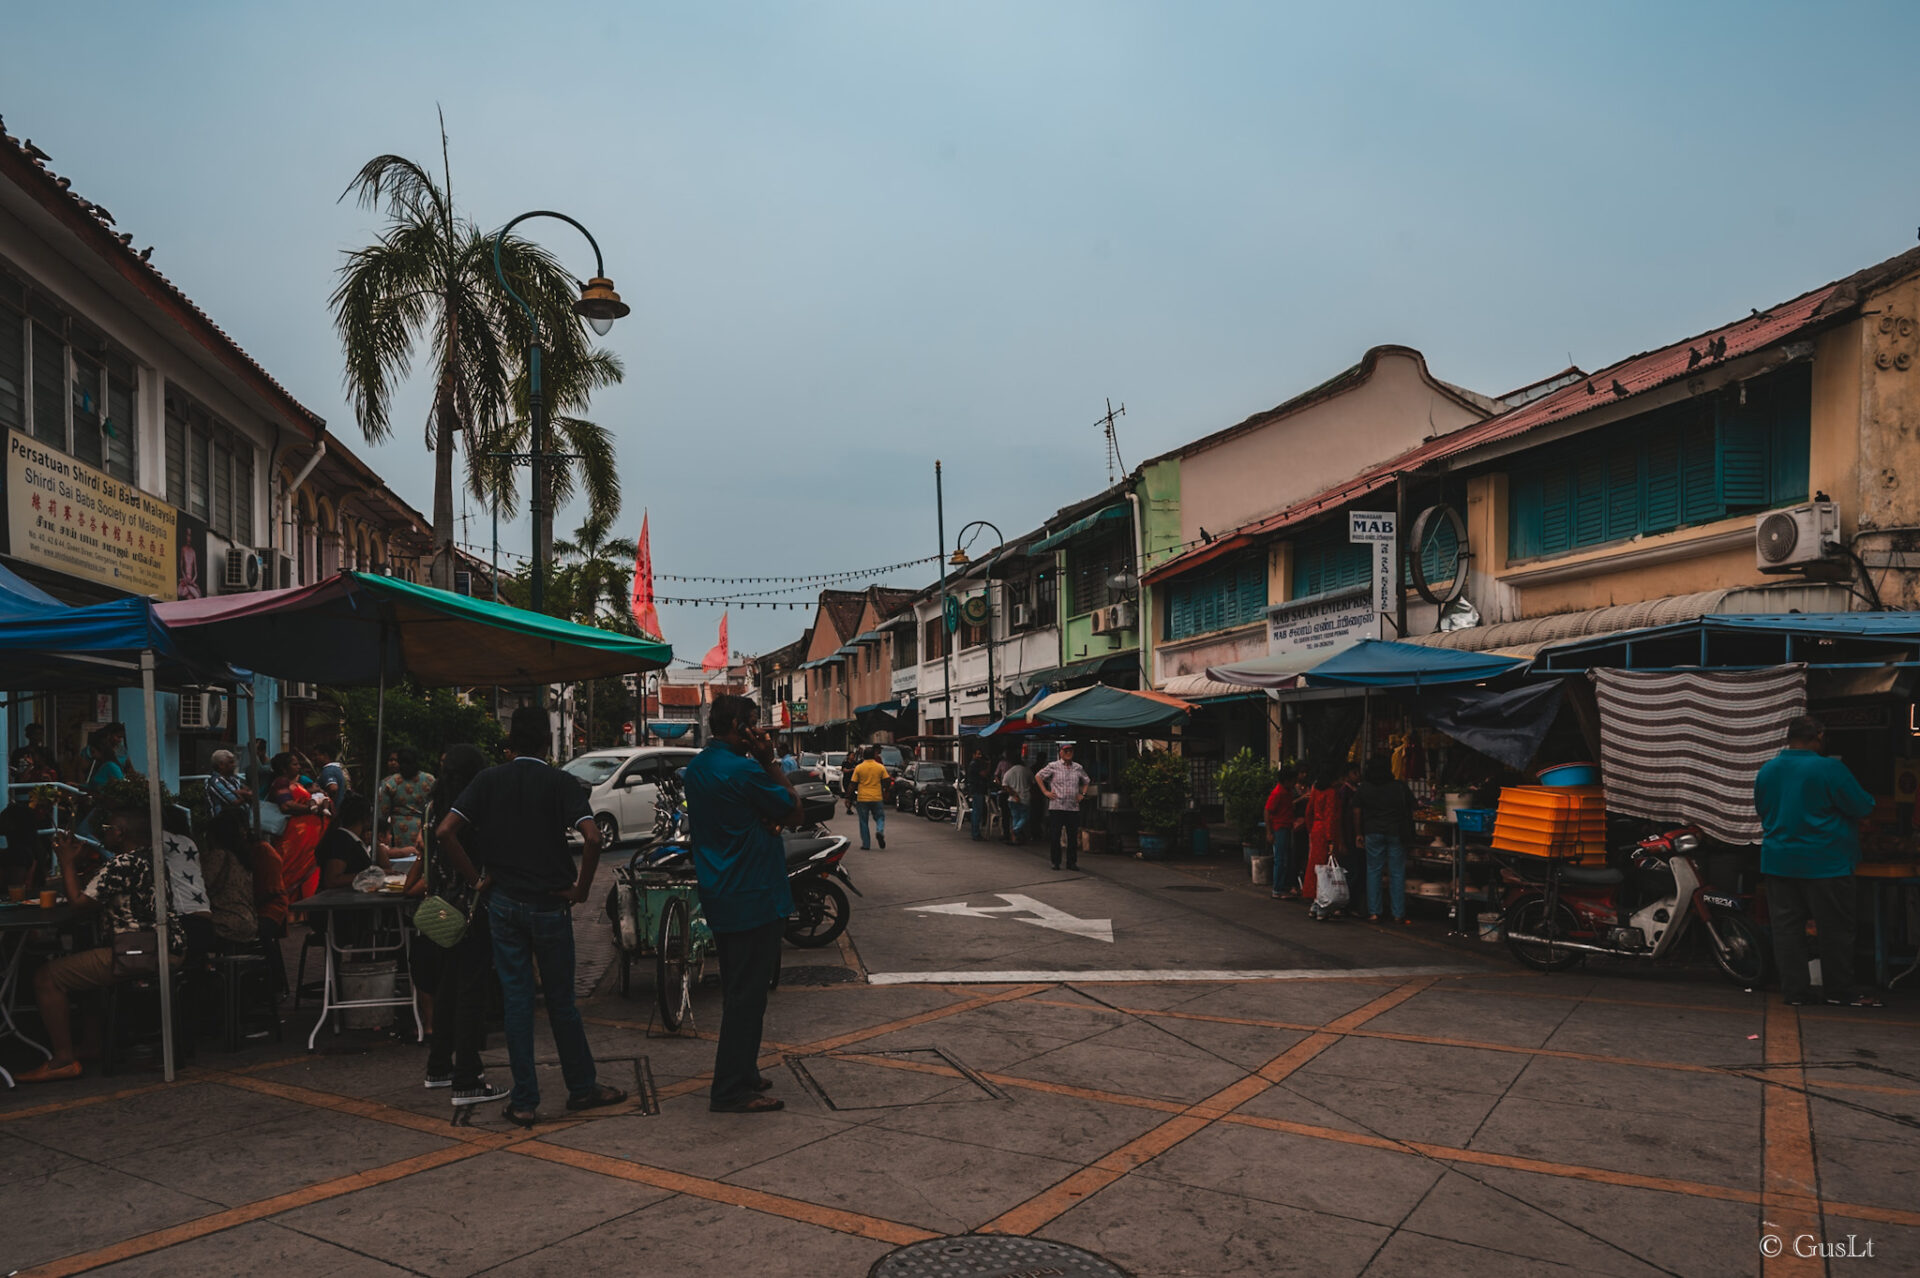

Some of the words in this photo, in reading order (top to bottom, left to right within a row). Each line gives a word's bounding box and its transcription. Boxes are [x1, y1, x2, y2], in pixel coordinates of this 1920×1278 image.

[11, 437, 70, 477] Persatuan
[73, 465, 100, 491] Shirdi
[103, 479, 116, 499] Sai
[119, 487, 141, 509] Baba
[143, 498, 176, 526] Malaysia
[25, 467, 56, 492] Shirdi
[59, 480, 73, 499] Sai
[76, 488, 95, 509] Baba
[97, 498, 127, 523] Society
[128, 513, 137, 526] of
[138, 519, 168, 540] Malaysia
[1353, 521, 1393, 533] MAB
[1272, 612, 1290, 626] MAB
[1291, 606, 1319, 622] SALAM
[1321, 593, 1373, 615] ENTERPRISE
[1273, 631, 1287, 641] MAB
